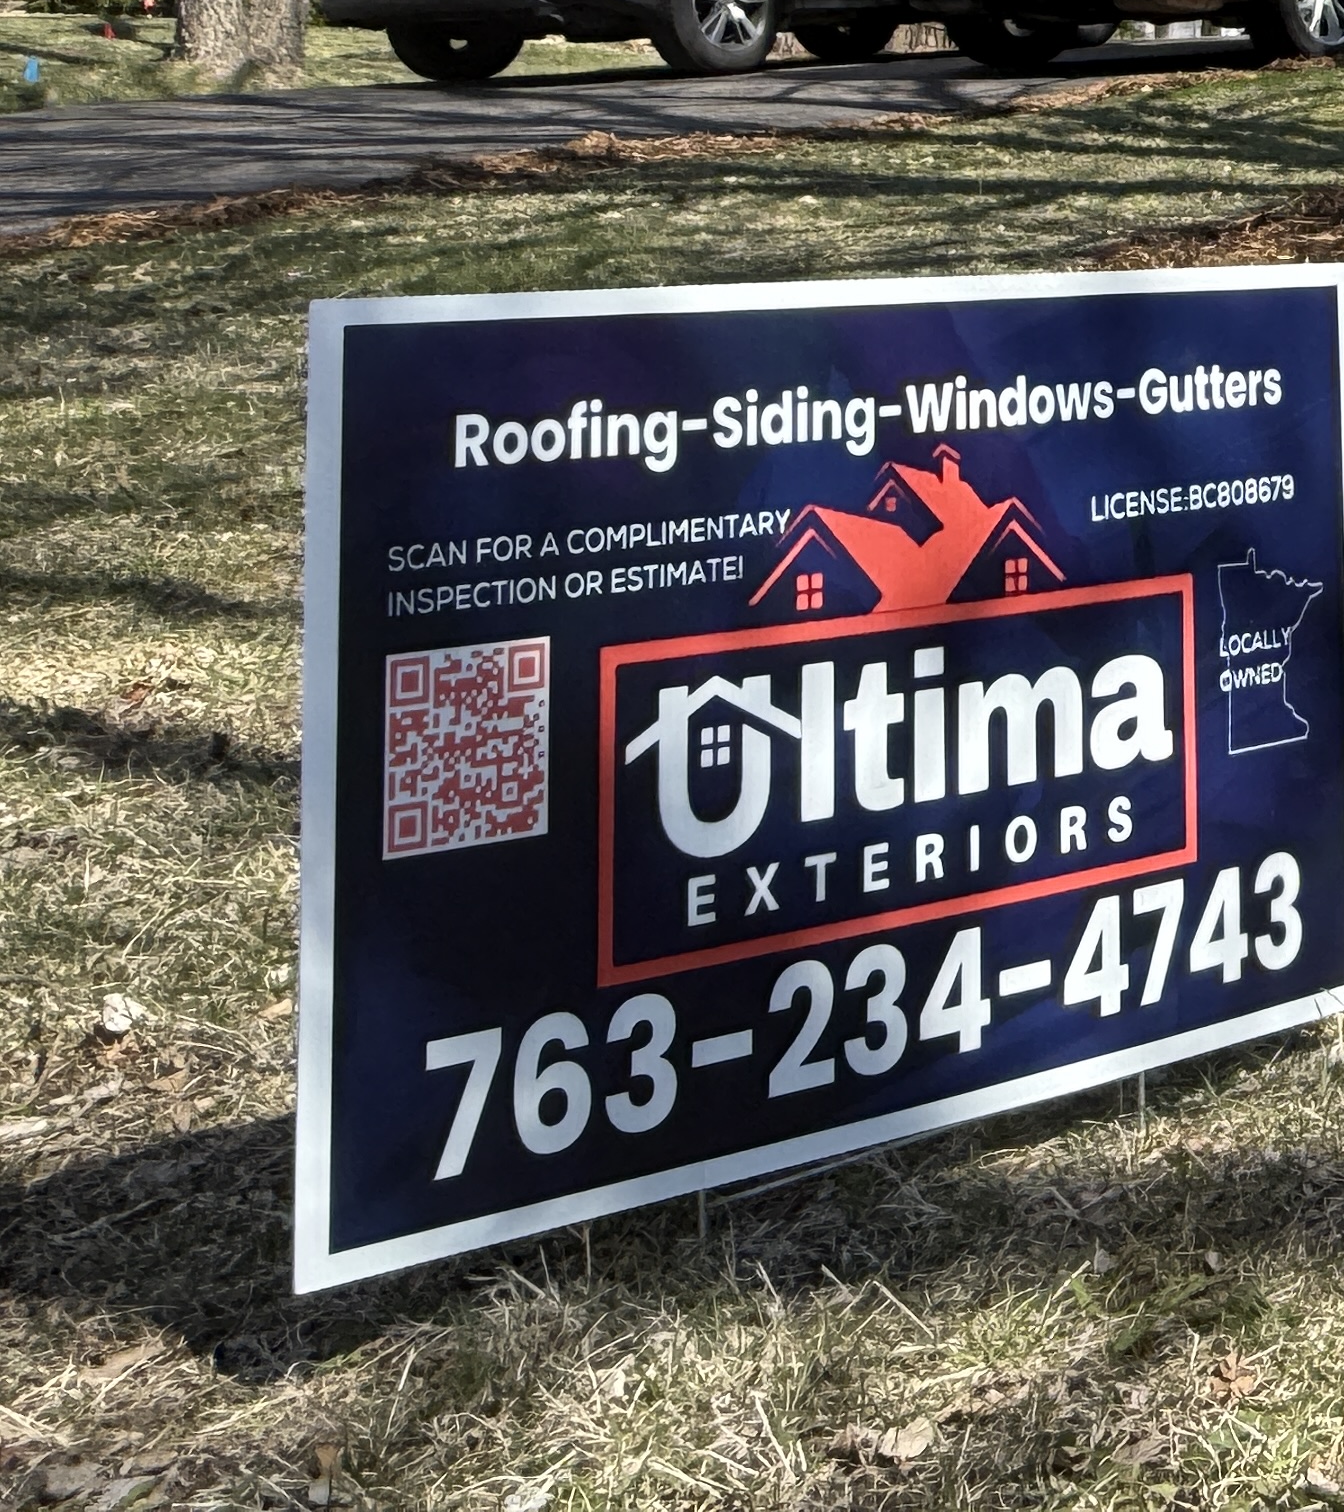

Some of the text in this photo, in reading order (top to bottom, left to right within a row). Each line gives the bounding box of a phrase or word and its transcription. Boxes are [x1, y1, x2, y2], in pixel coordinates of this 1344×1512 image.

[454, 364, 1283, 473] Roofing-Siding-Windows-Gutters
[1090, 473, 1295, 522] LICENSE:BC808679
[388, 508, 792, 572] SCAN FOR A COMPLIMENTARY
[387, 554, 745, 617] INSPECTION OR ESTIMATE!
[1219, 626, 1292, 657] LOCALLY
[1219, 662, 1283, 692] OWNED
[625, 646, 1174, 858] Ultima
[687, 795, 1133, 926] EXTERIORS
[425, 851, 1303, 1181] 763-234-4743
